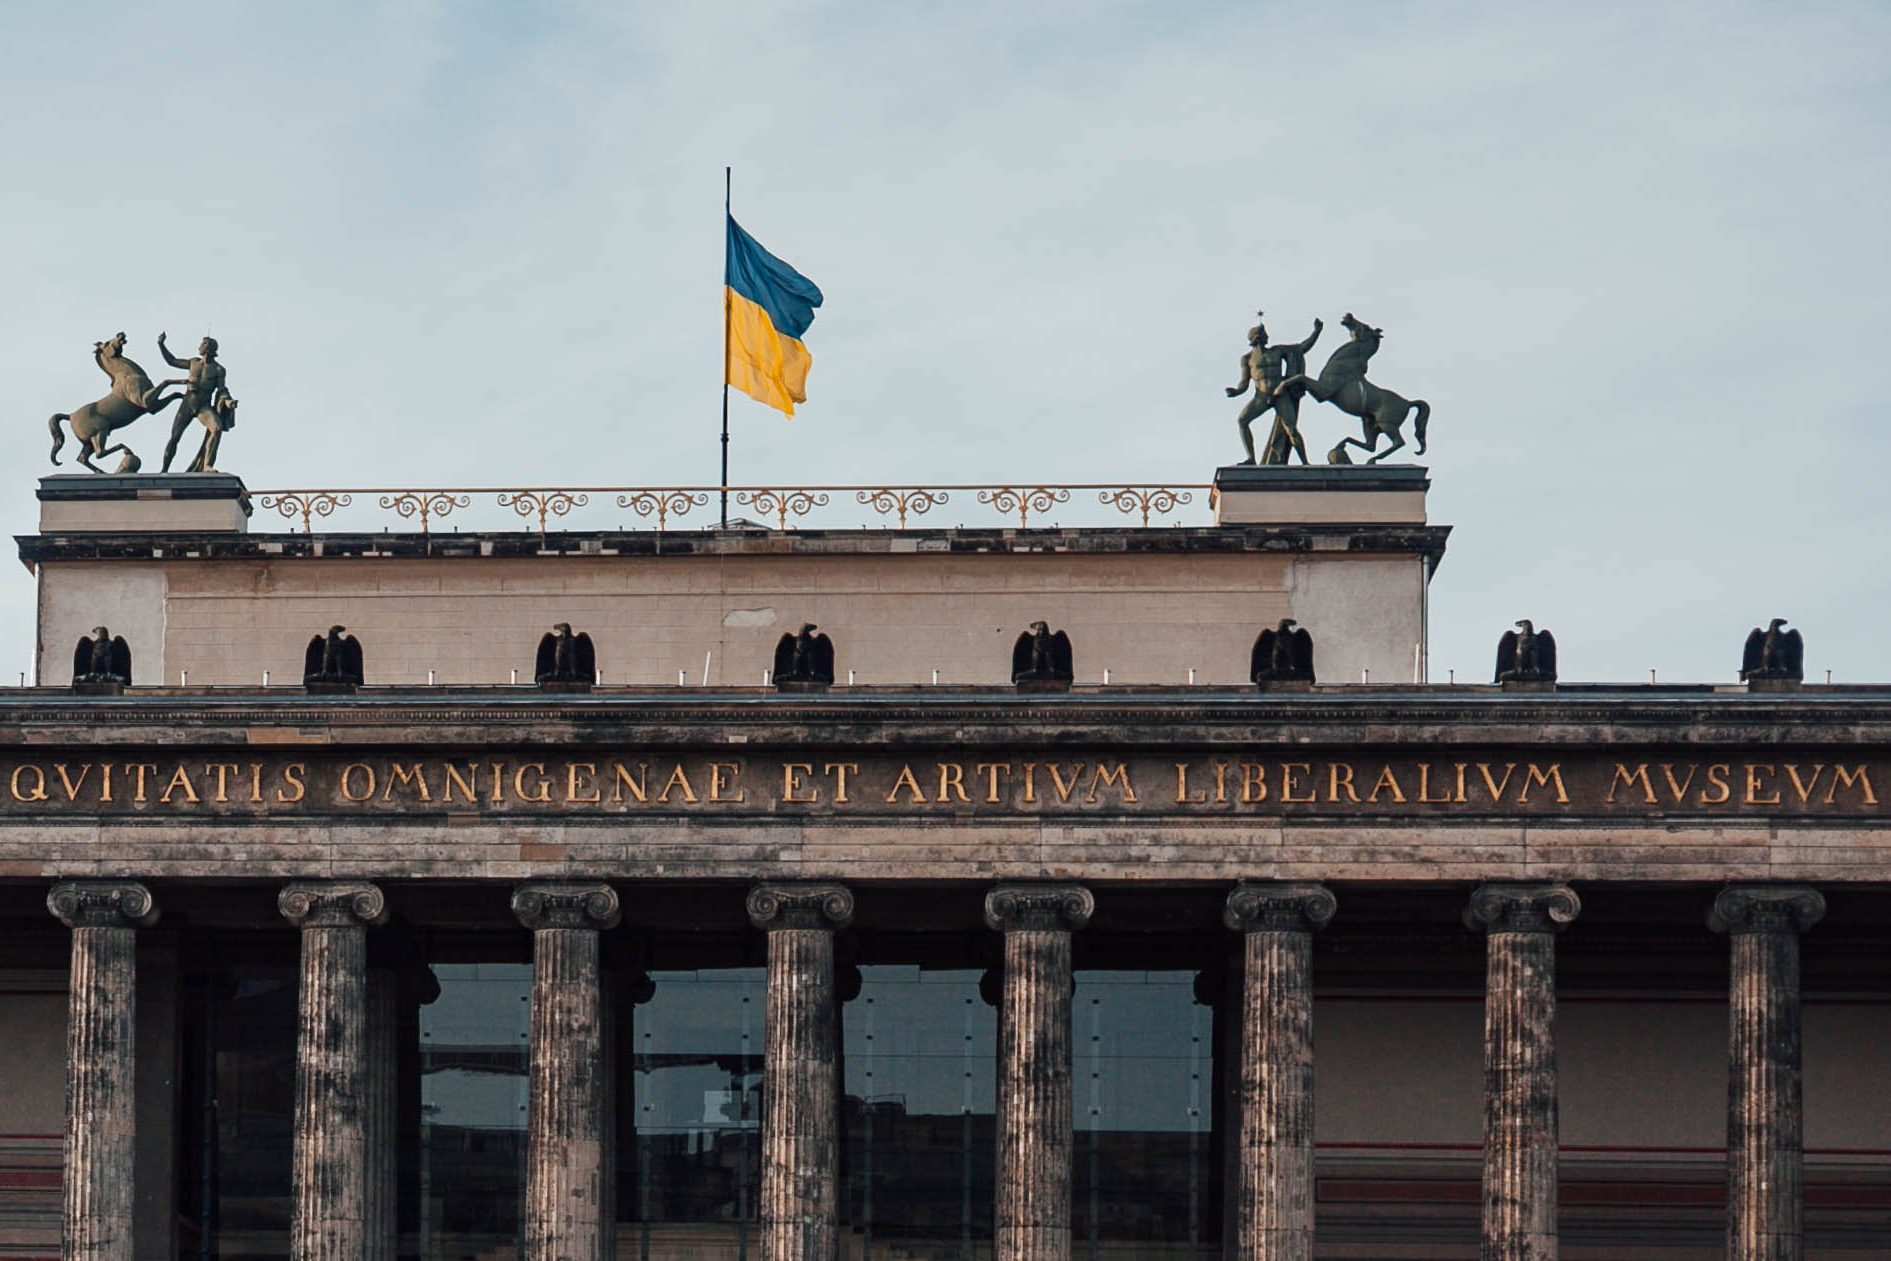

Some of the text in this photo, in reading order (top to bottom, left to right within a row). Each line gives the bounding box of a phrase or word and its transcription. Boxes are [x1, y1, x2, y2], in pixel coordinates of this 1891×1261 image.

[339, 762, 745, 804] OMNIGENAE
[781, 762, 859, 804] ET
[886, 762, 1139, 805] ARTIVM
[1175, 762, 1570, 804] LIBERALIVM
[1607, 763, 1878, 805] MVSEVM
